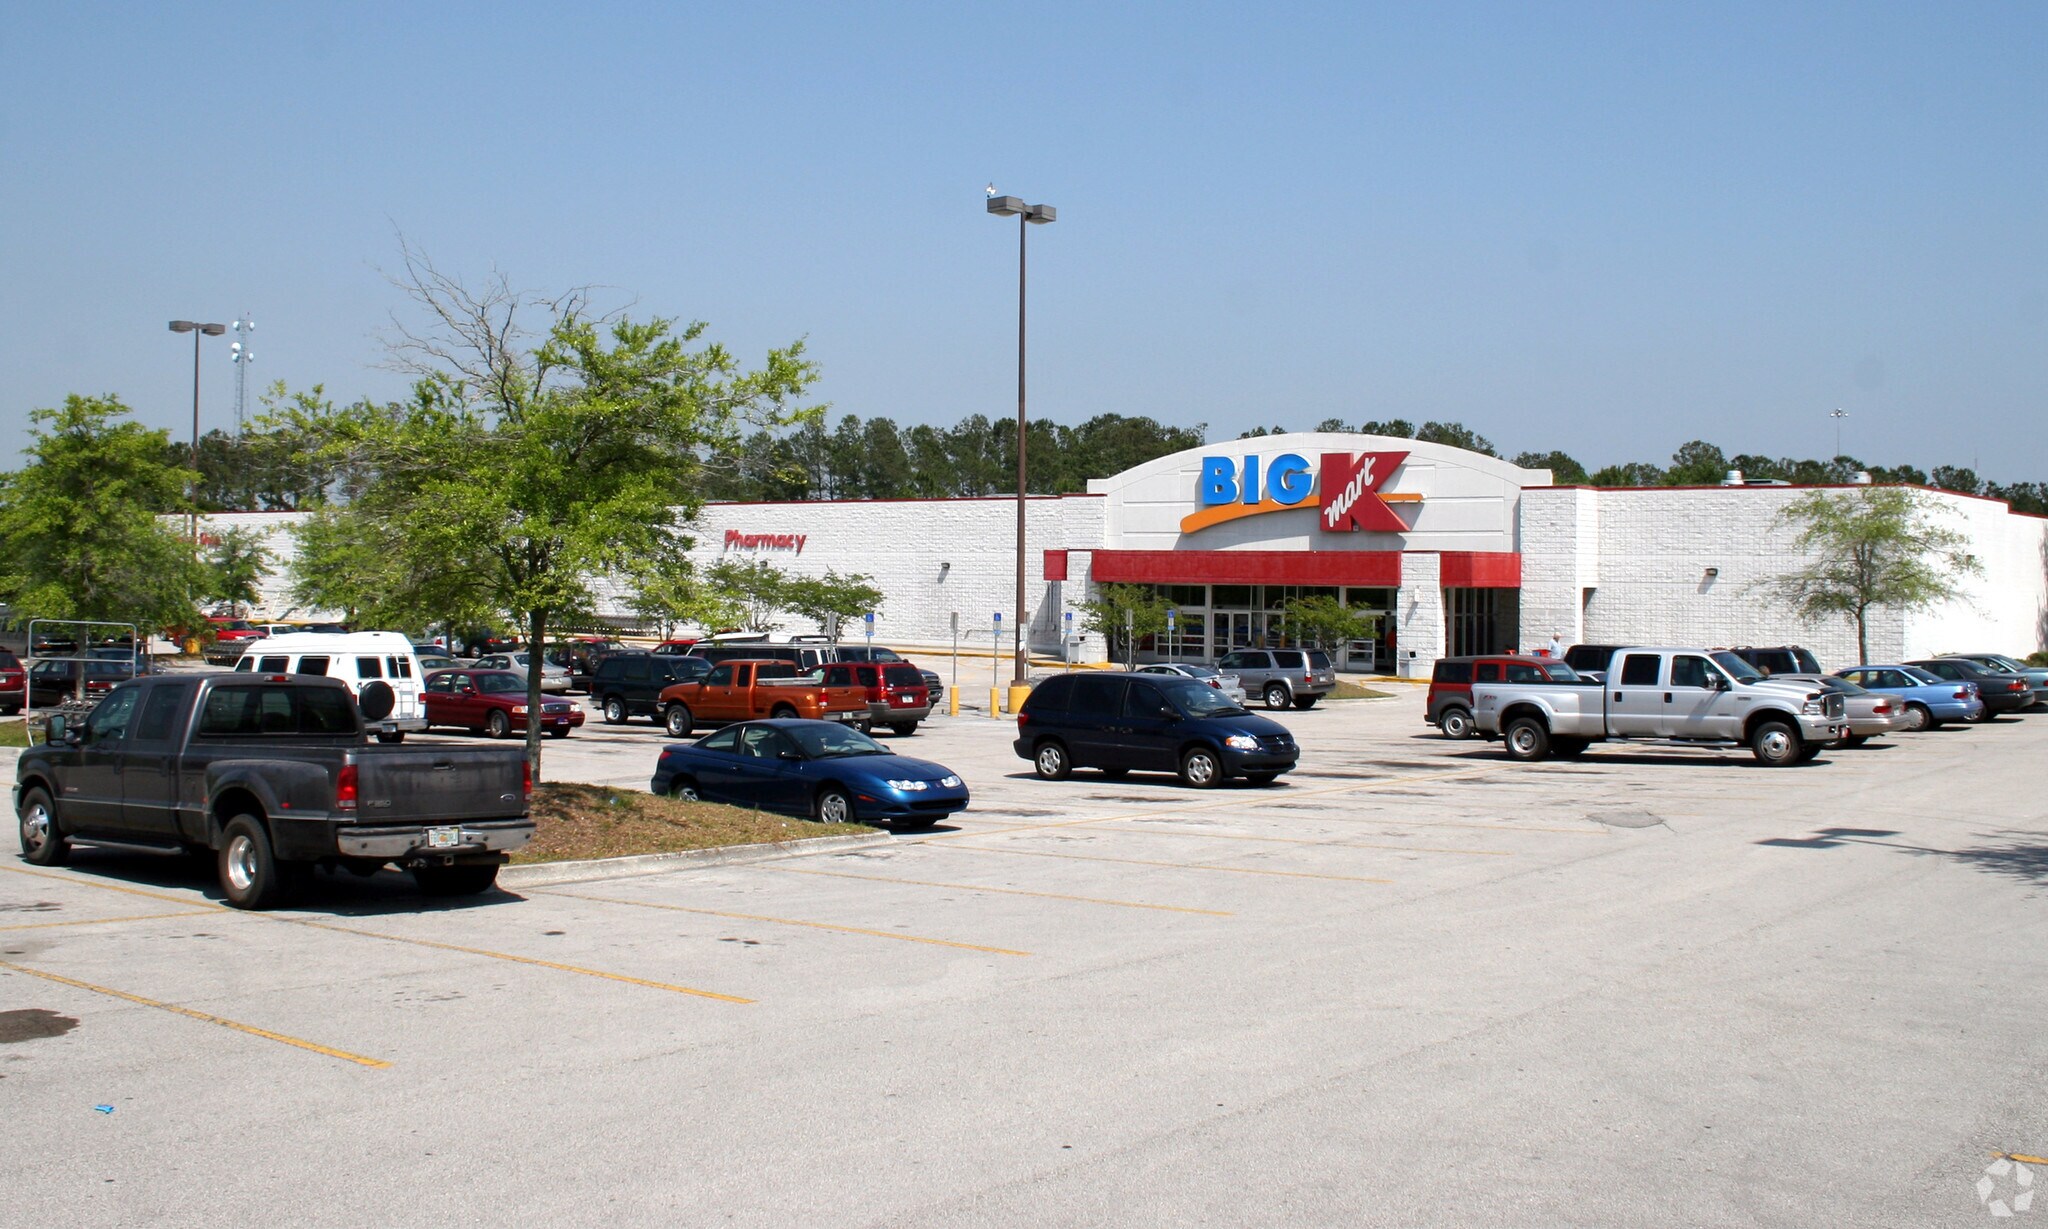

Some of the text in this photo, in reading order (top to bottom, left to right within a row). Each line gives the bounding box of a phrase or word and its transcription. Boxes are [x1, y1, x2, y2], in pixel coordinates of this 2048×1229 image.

[1202, 451, 1411, 532] BIG K
[1324, 458, 1376, 527] mart
[724, 529, 807, 555] Pharmacy
